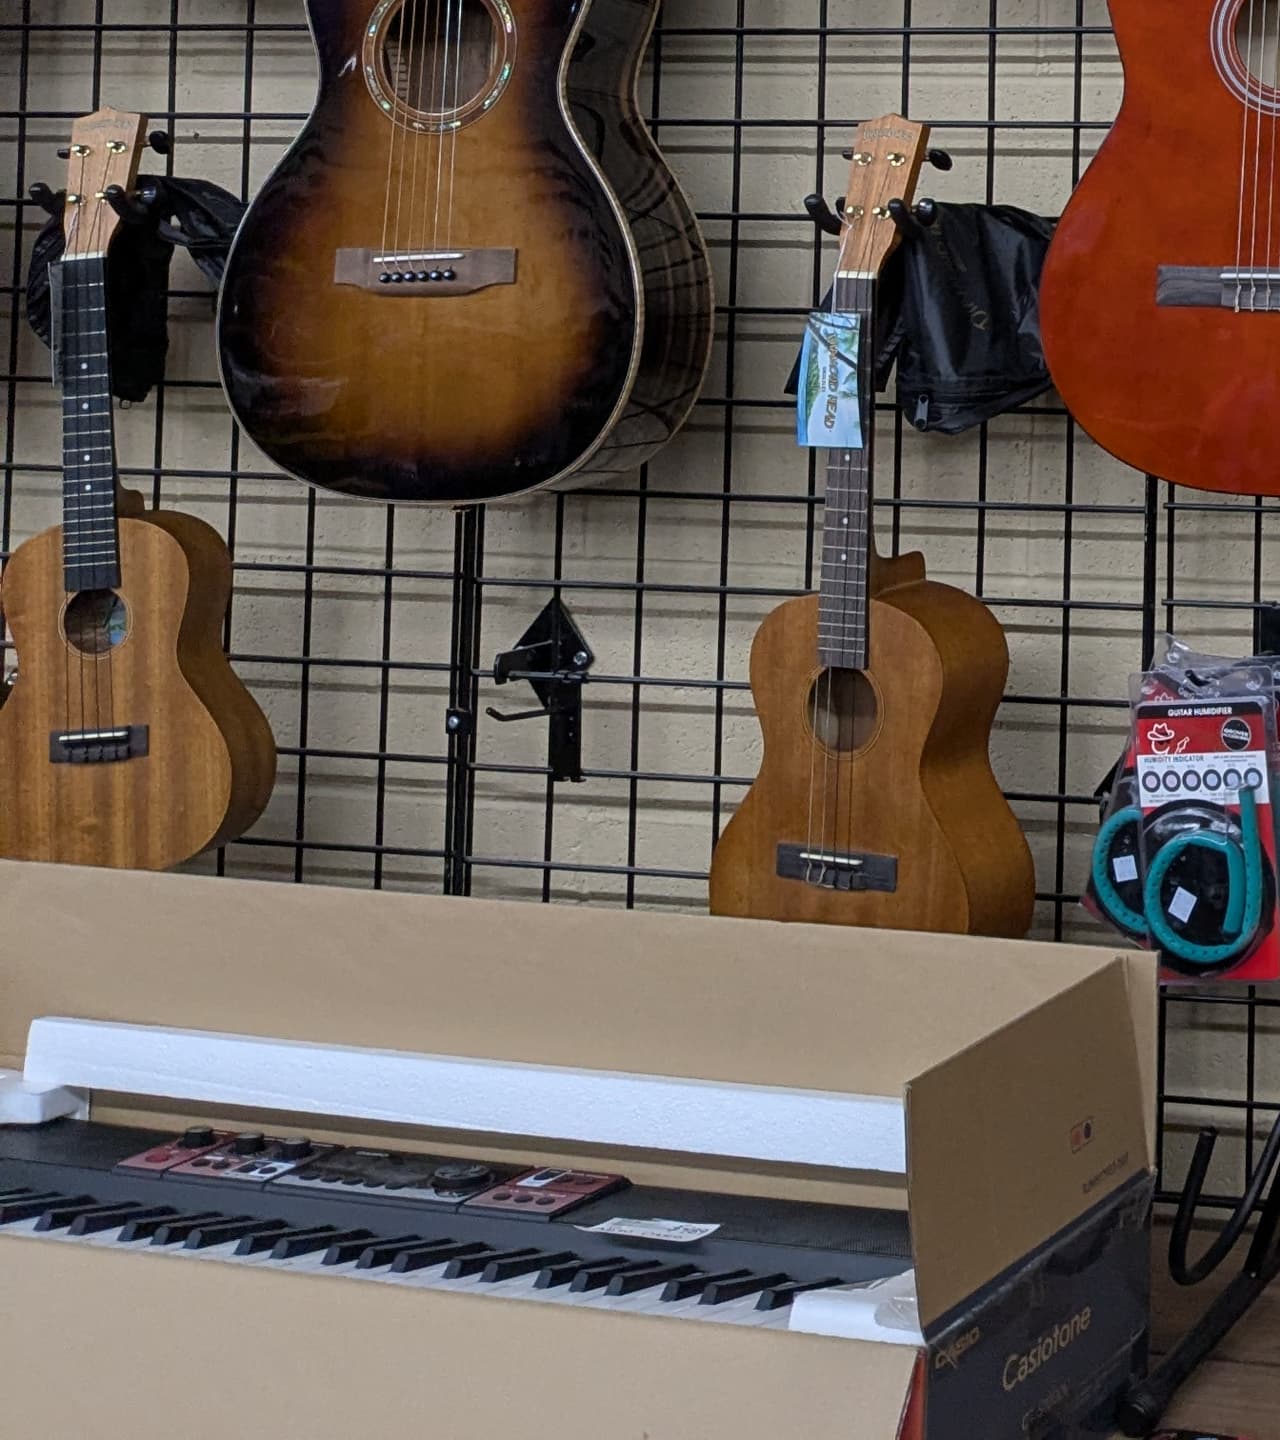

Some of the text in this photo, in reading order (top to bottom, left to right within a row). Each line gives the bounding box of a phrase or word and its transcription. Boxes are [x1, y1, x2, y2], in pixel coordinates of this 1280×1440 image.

[1168, 706, 1232, 717] GUITAR HUMIDIFIER
[1144, 756, 1172, 764] HUMIDITY
[1173, 755, 1204, 763] INDICATOR
[1001, 1305, 1092, 1393] Casiotone
